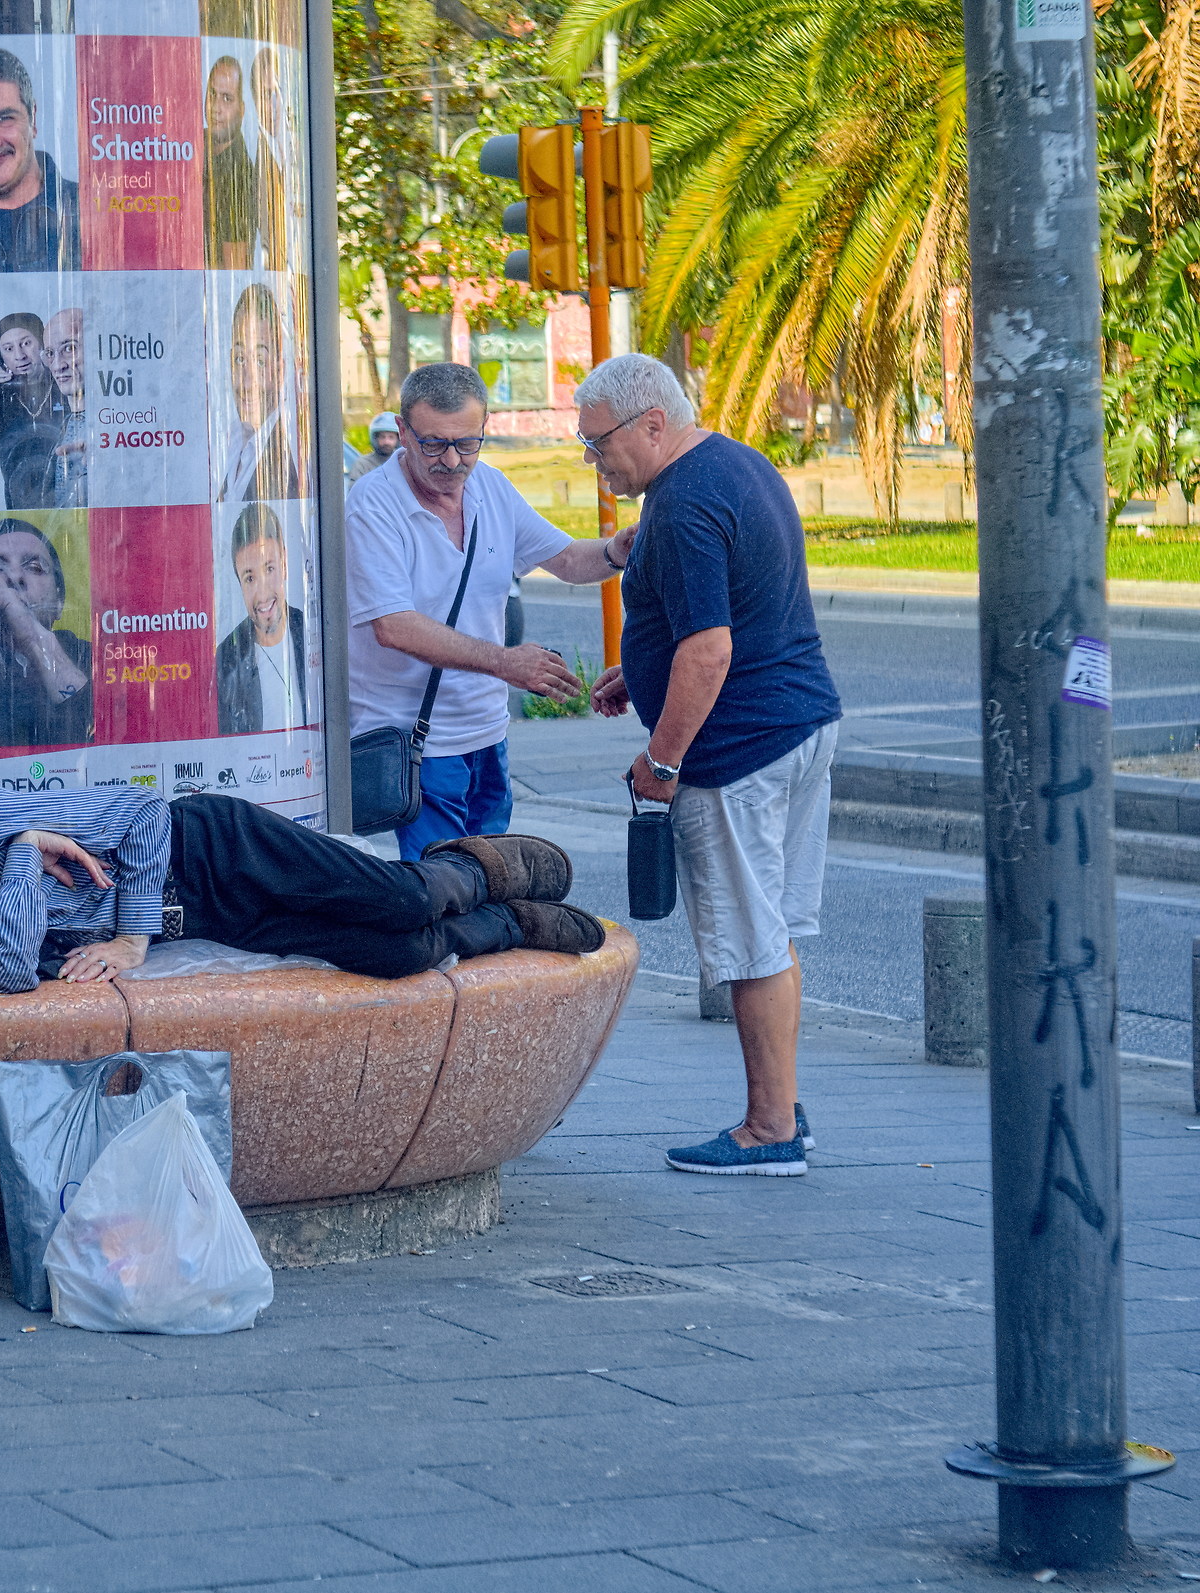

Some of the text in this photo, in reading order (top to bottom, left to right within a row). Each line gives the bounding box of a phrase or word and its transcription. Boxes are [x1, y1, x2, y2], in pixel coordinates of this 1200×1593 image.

[90, 97, 163, 125] Simone
[91, 133, 194, 161] Schettino
[108, 195, 181, 213] AGOSTO
[98, 332, 164, 360] I Ditelo
[97, 368, 133, 397] Voi
[98, 405, 157, 425] Giovedì
[99, 429, 185, 449] 3 AGOSTO
[101, 606, 208, 634] Clementino
[104, 642, 158, 660] Sabato
[105, 663, 192, 684] 5 AGOSTO
[280, 765, 305, 779] expert
